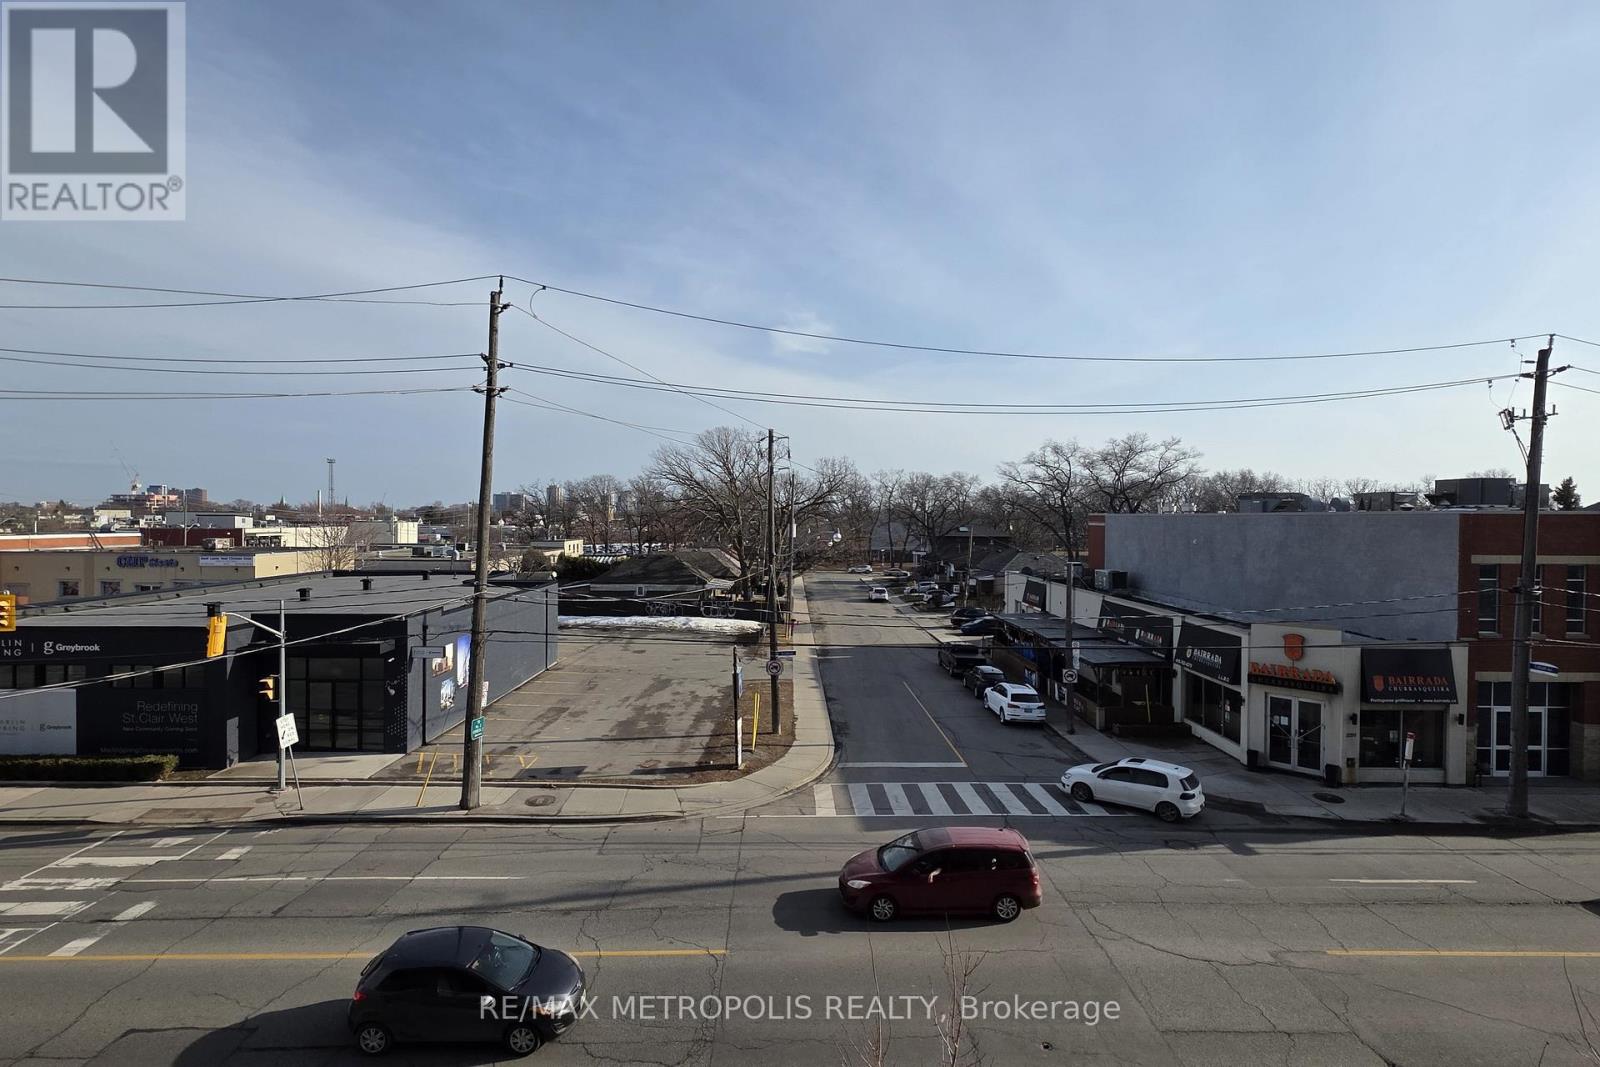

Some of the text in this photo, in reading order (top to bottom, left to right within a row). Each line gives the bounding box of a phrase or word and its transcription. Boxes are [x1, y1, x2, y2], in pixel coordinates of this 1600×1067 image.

[55, 643, 101, 653] Greybrook
[1193, 648, 1222, 665] BAIRRADA
[1249, 661, 1337, 685] BAIRRADA
[1388, 676, 1449, 686] BAIRRADA
[136, 700, 198, 713] Redefining
[168, 711, 200, 723] West
